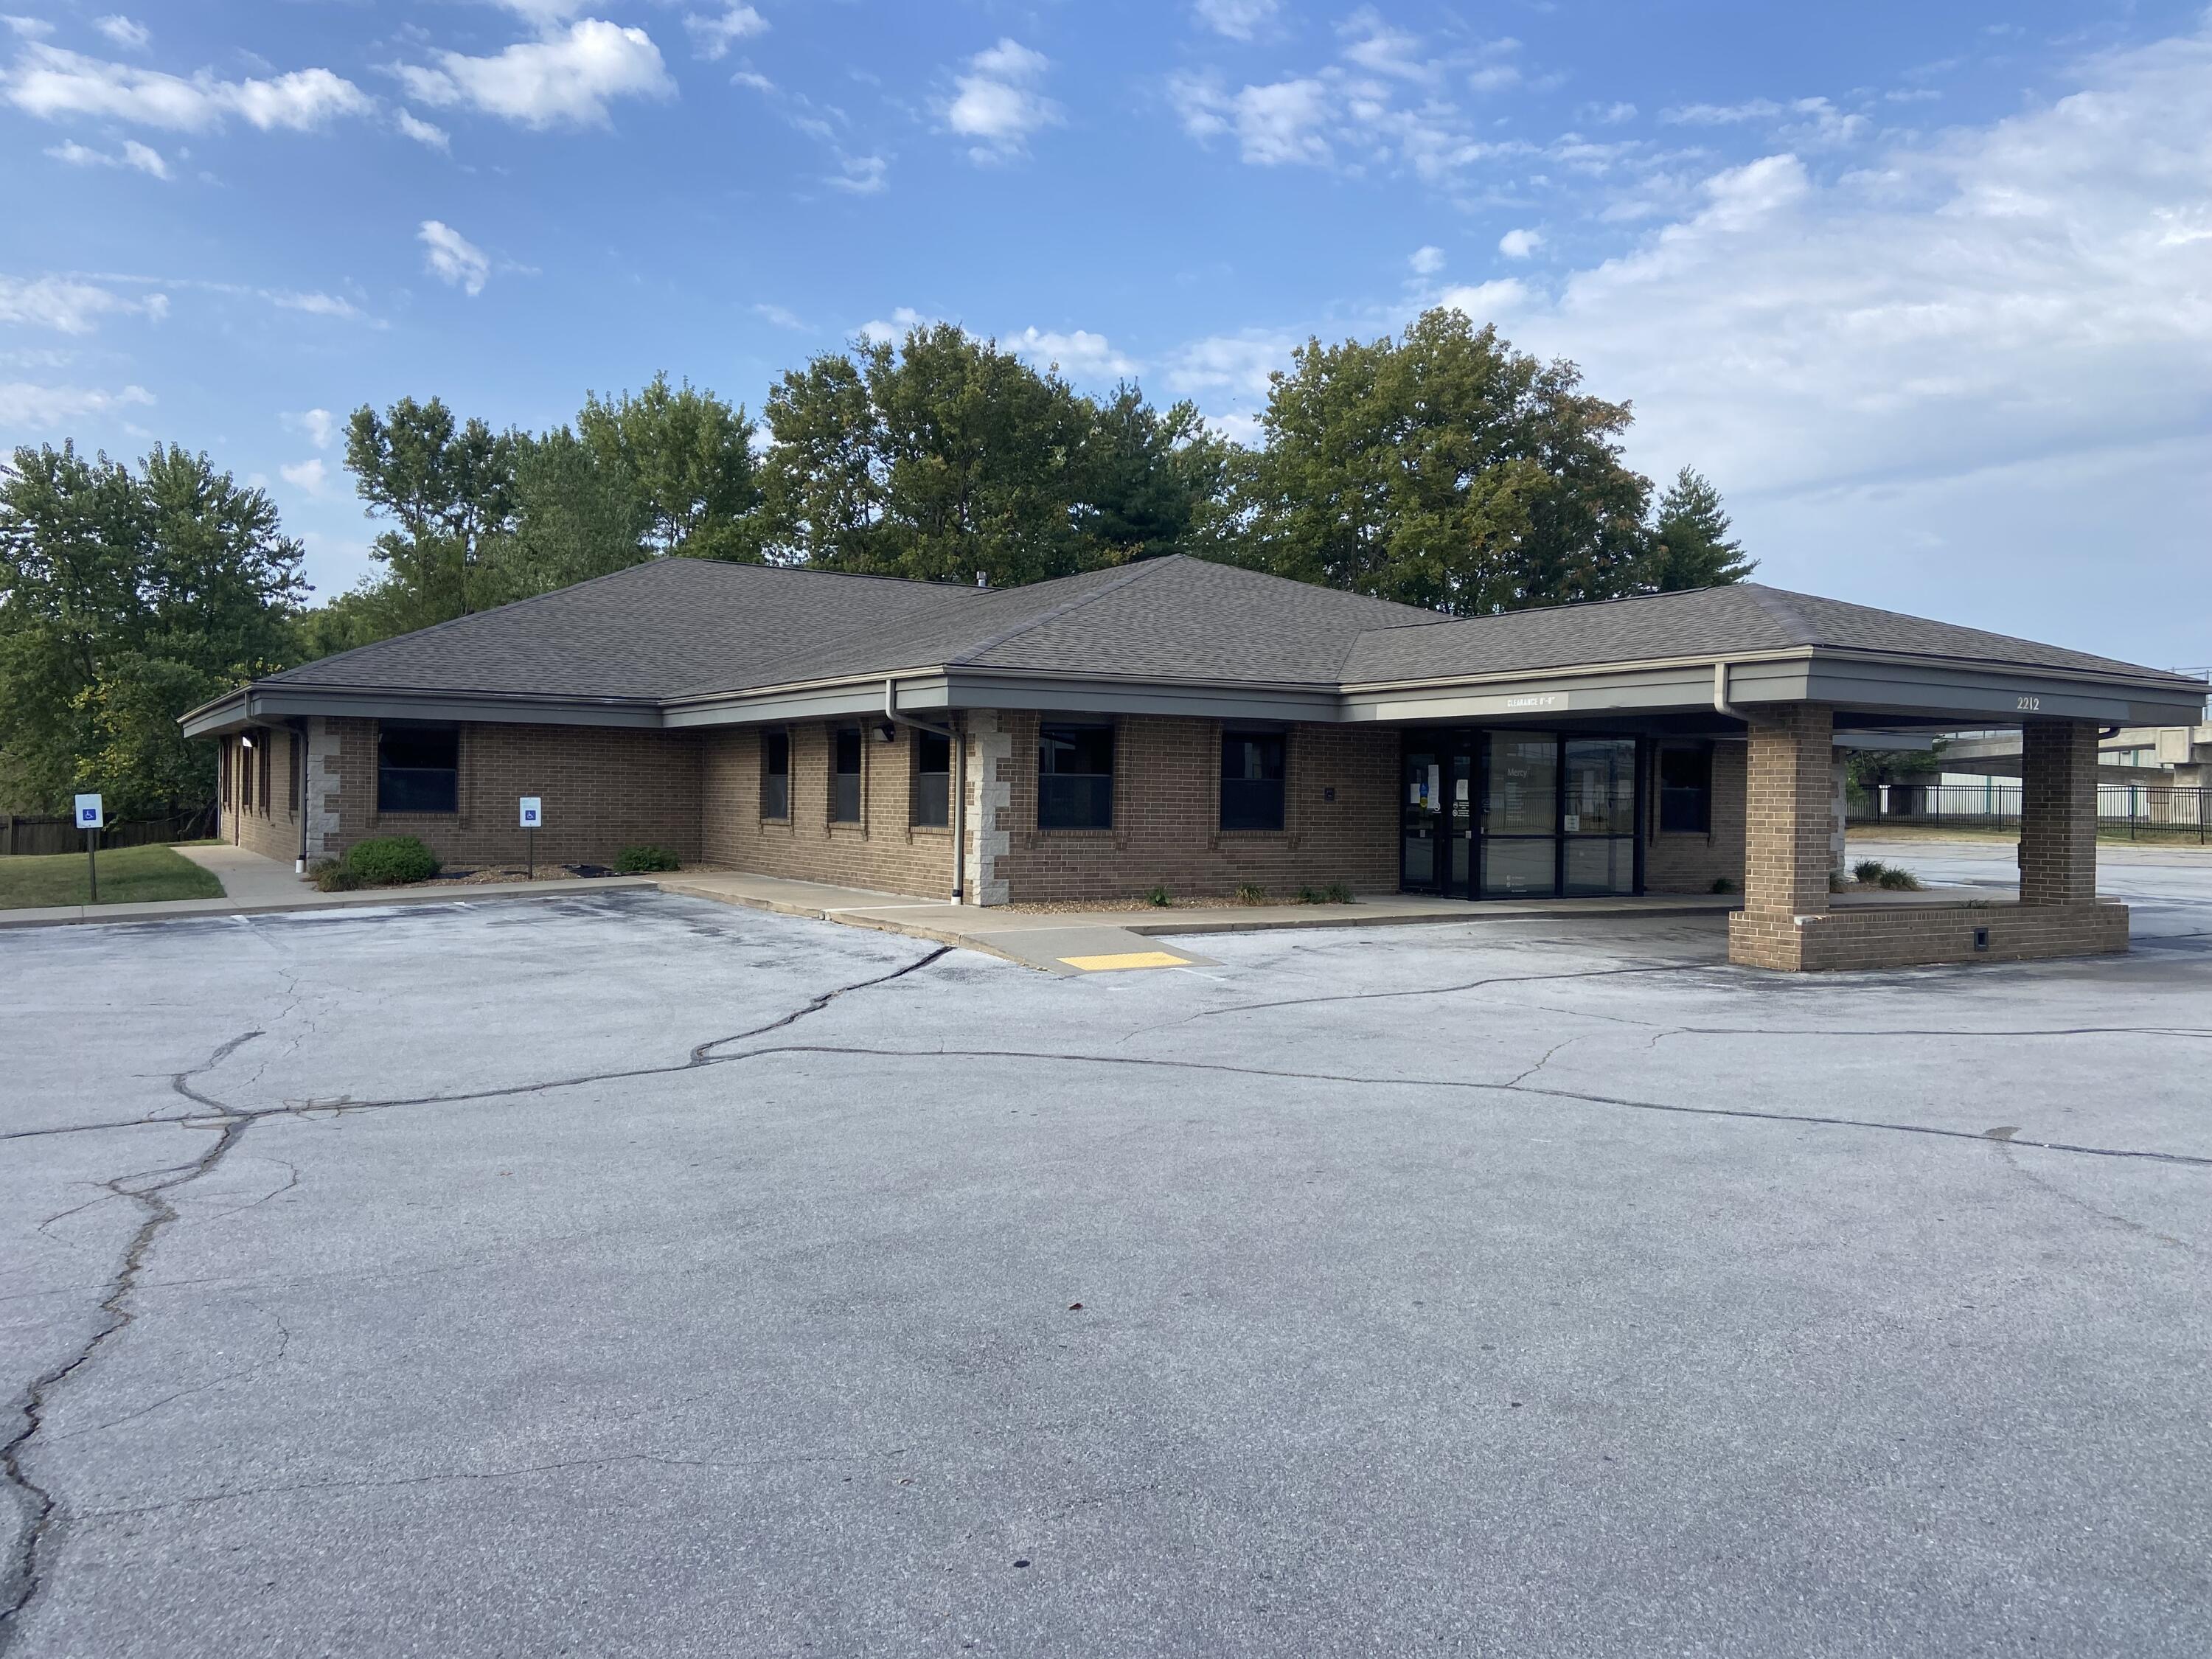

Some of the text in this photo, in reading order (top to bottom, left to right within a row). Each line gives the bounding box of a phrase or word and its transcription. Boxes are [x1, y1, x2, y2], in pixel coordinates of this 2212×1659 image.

[1507, 698, 1539, 707] CLEARANCE
[2017, 696, 2039, 710] 2212
[1507, 768, 1527, 779] Mercy
